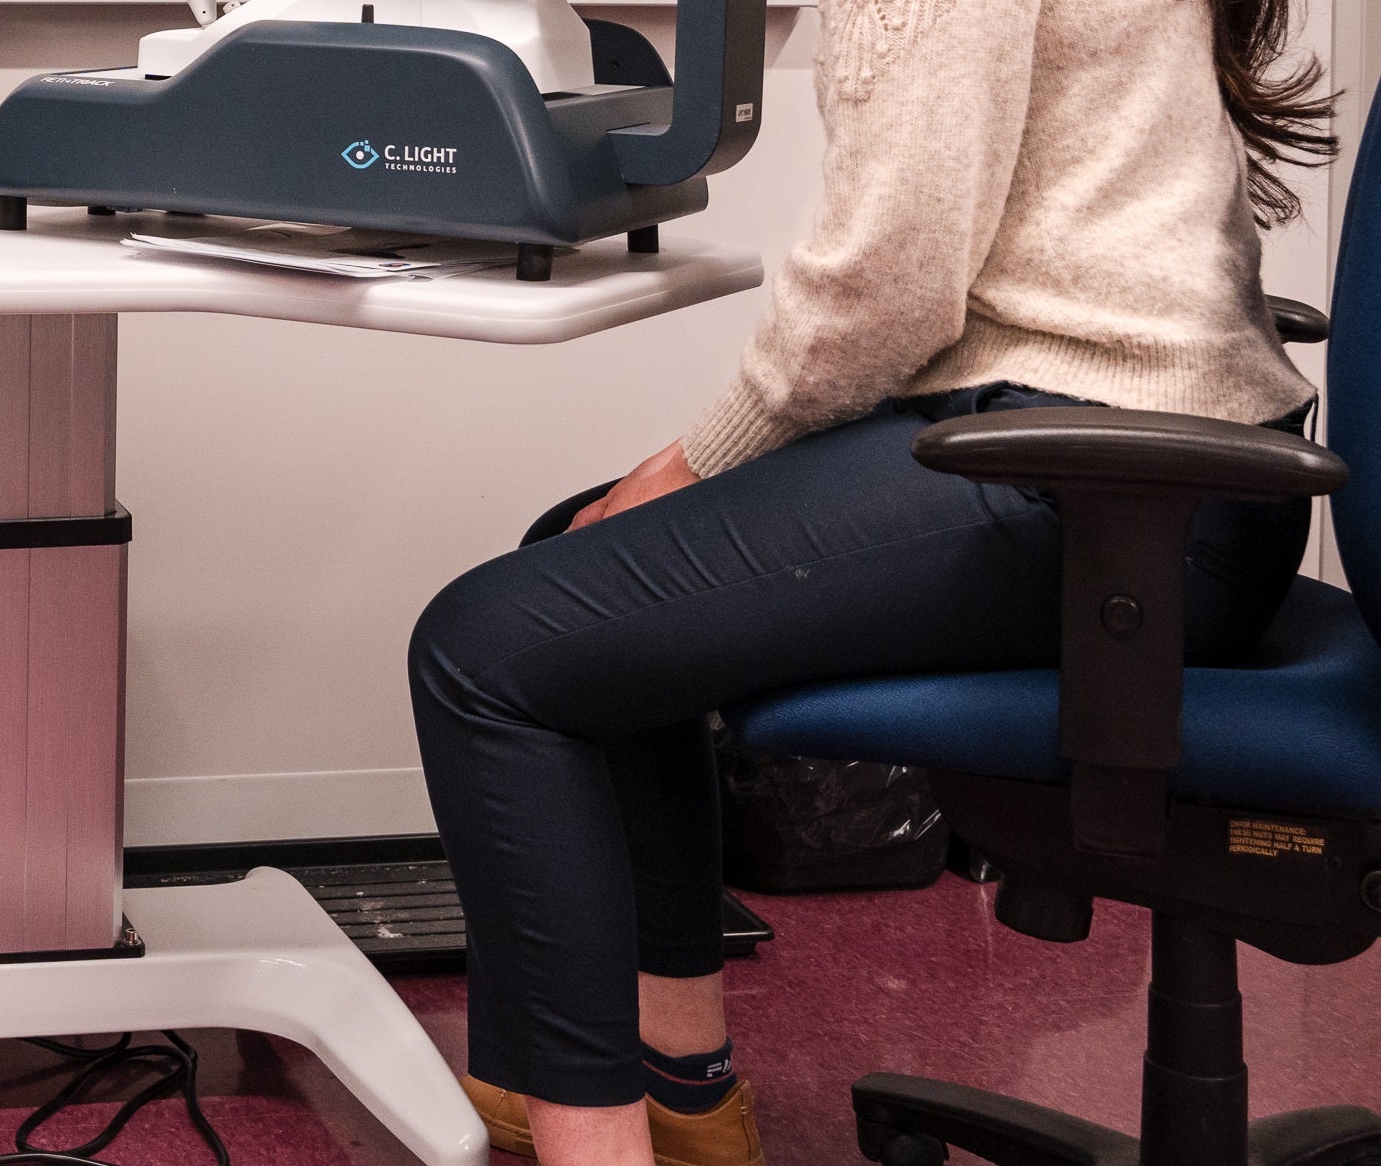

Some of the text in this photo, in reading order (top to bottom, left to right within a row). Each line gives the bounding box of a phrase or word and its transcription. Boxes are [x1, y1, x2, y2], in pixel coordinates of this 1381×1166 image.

[384, 144, 457, 164] C. LIGHT
[385, 163, 457, 174] TECHNOLOGIES
[1273, 841, 1291, 850] HALF
[1292, 835, 1325, 846] REQUIRE
[1229, 845, 1278, 856] PERIODICALLY
